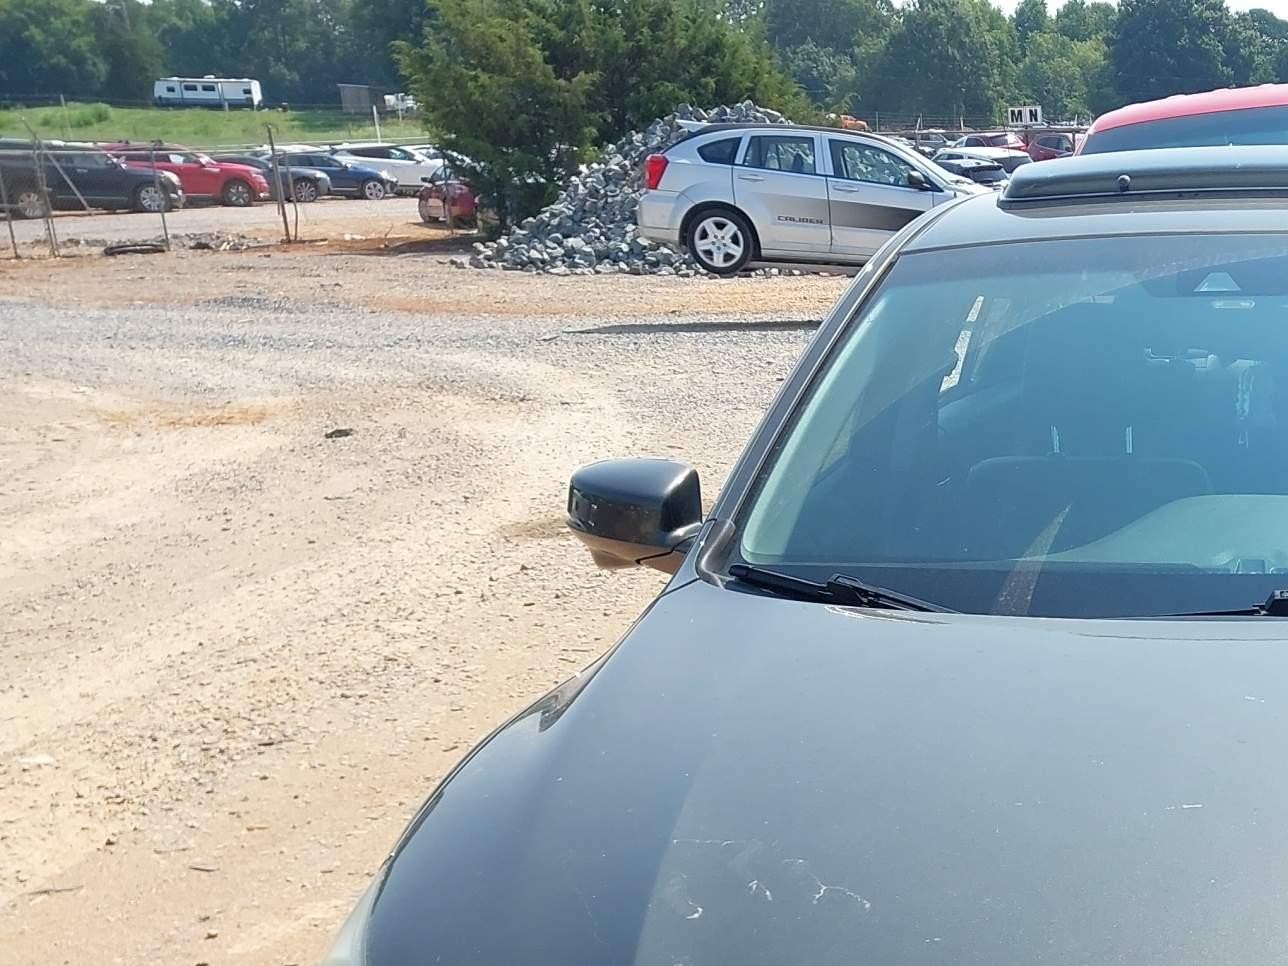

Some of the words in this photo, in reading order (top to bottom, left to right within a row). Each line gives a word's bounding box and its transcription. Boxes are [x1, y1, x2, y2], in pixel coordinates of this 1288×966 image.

[1010, 109, 1023, 123] M
[1029, 109, 1038, 122] N
[777, 215, 824, 225] CALIBER
